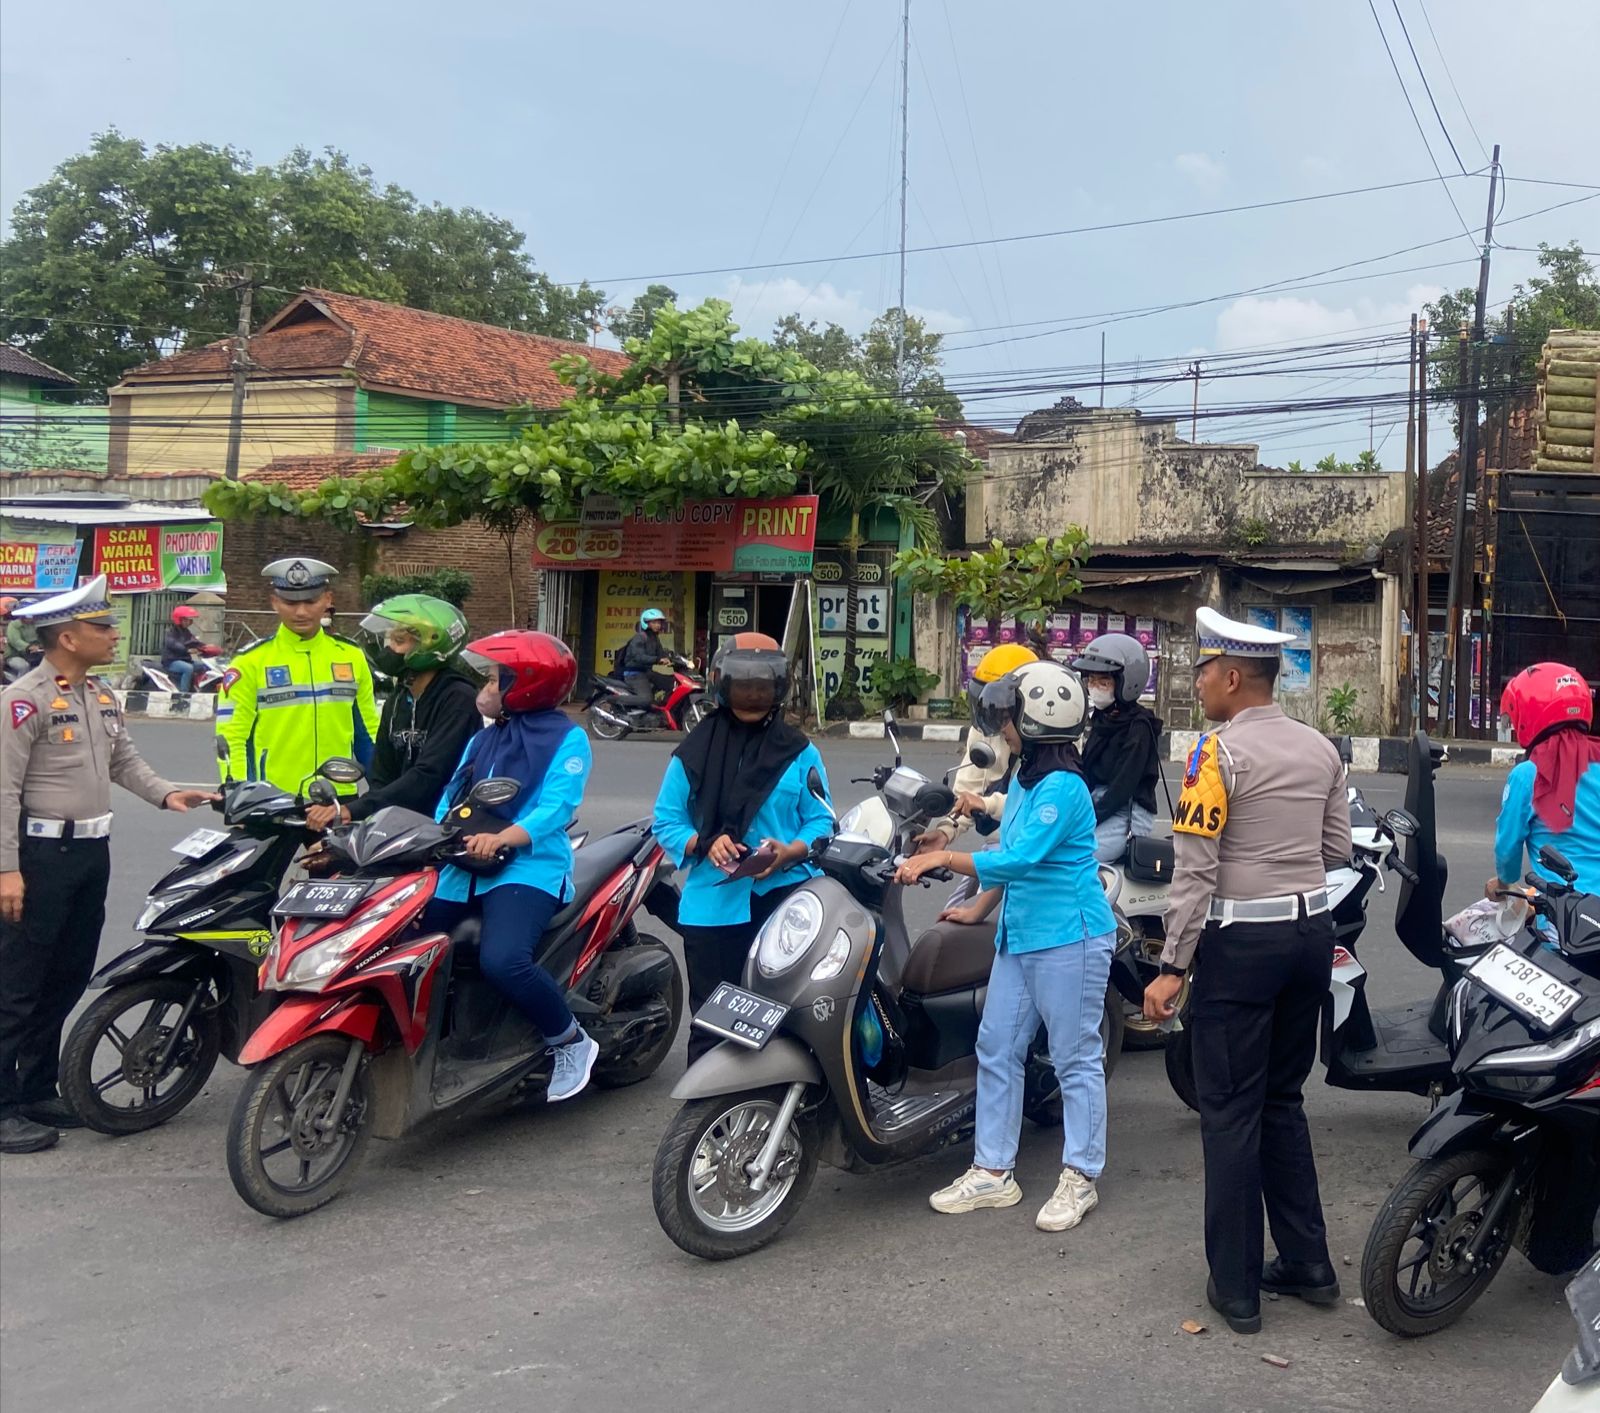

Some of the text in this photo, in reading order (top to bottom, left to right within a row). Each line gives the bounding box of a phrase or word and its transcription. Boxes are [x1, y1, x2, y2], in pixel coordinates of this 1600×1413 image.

[690, 503, 735, 524] COPY
[742, 507, 813, 536] PRINT
[109, 529, 147, 543] SCAN
[102, 544, 153, 558] WARNA
[545, 538, 580, 555] 20
[585, 540, 619, 552] 200
[100, 558, 155, 574] DIGITAL
[176, 556, 211, 575] WARNA
[798, 556, 810, 567] 500
[820, 570, 840, 579] 500
[859, 572, 879, 580] 200
[606, 584, 650, 596] Cetak
[819, 594, 880, 629] prnt
[726, 615, 745, 625] 500
[820, 646, 840, 660] ge
[1175, 801, 1221, 832] WAS
[289, 886, 304, 898] K
[1128, 892, 1169, 904] SCOO
[179, 909, 216, 927] HONDA
[355, 946, 390, 971] HONDA
[1487, 948, 1574, 1009] K 4387 CAA
[713, 989, 728, 1005] K
[728, 995, 760, 1017] 6207
[928, 1103, 975, 1136] HOND
